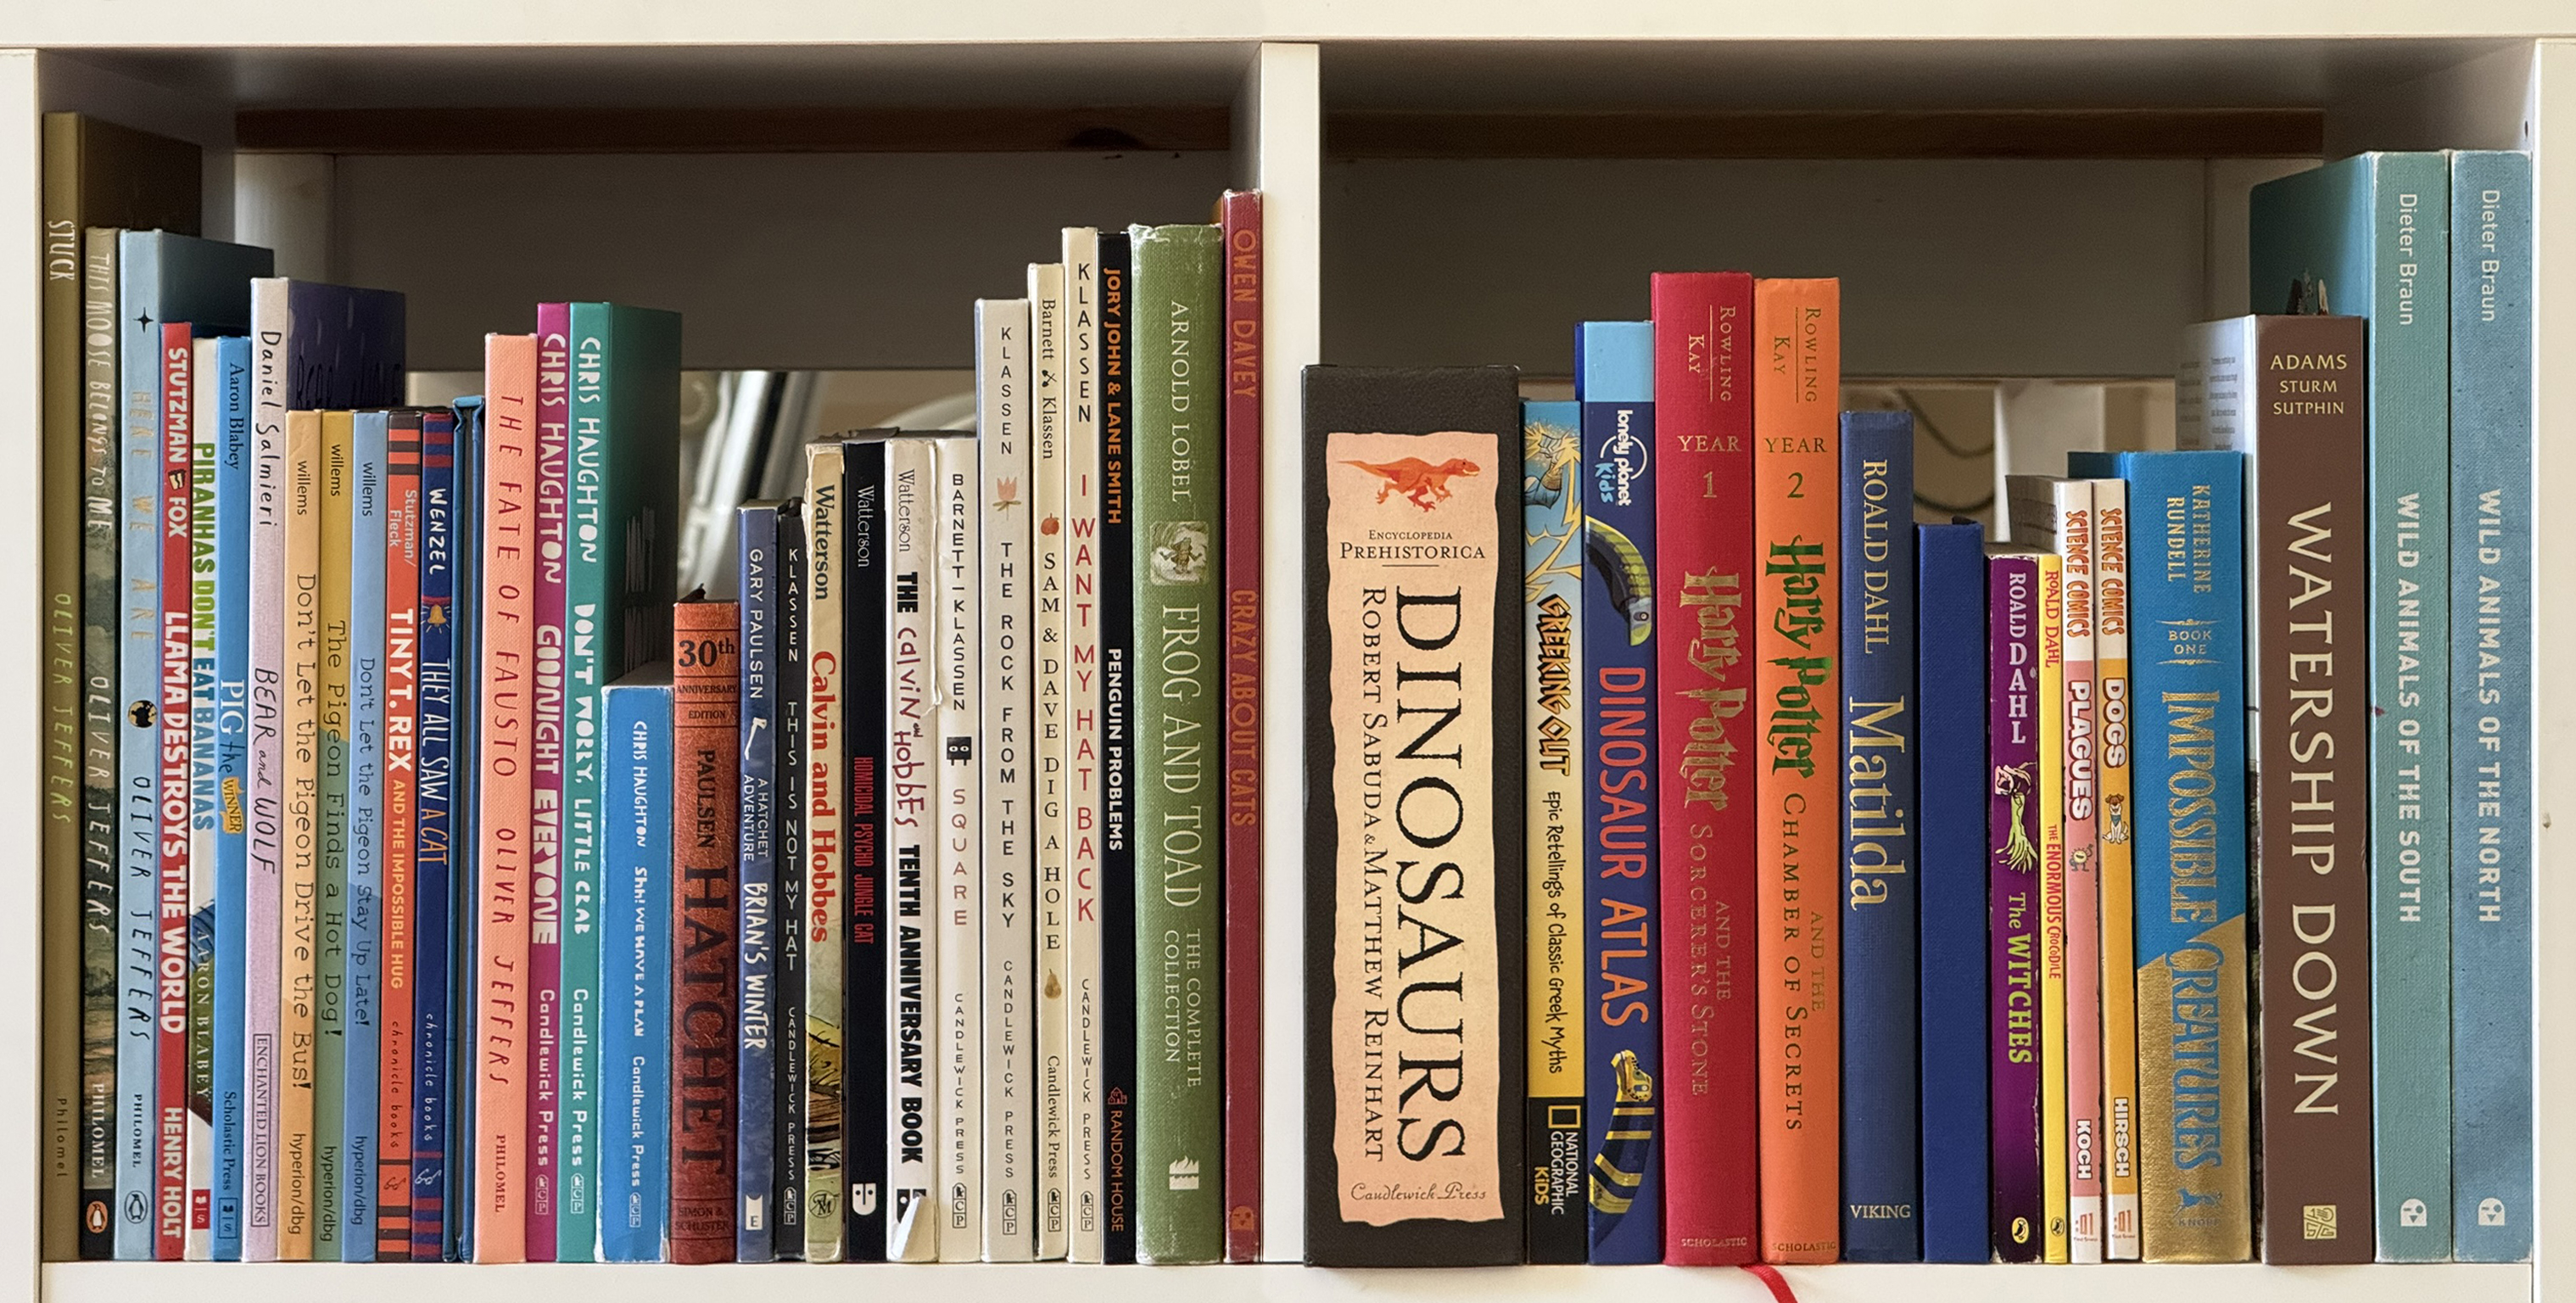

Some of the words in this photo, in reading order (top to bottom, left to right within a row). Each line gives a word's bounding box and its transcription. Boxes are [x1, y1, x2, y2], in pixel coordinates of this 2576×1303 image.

[48, 221, 75, 281] STUCK
[2400, 194, 2417, 256] Dieter
[2482, 190, 2499, 253] Dieter
[1107, 269, 1122, 318] JORY
[2400, 264, 2417, 326] Braun
[2482, 260, 2499, 322] Braun
[1042, 299, 1056, 360] Barnett
[1107, 322, 1122, 376] JOHN
[1171, 300, 1190, 412] ARNOLD
[2270, 353, 2348, 370] ADAMS
[228, 362, 244, 413] Aaron
[260, 331, 282, 408] Daniel
[541, 333, 565, 405] CHRIS
[1107, 382, 1122, 396] &
[2280, 382, 2338, 394] STURM
[225, 417, 245, 469] Blabey
[1042, 396, 1056, 459] Klassen
[1107, 402, 1122, 456] LANE
[1678, 435, 1743, 452] YEAR
[1764, 438, 1827, 453] YEAR
[2274, 403, 2344, 416] SUTPHIN
[257, 423, 279, 526] Salmieri
[330, 444, 344, 496] willems
[1107, 461, 1122, 524] SMITH
[1171, 423, 1191, 503] LOBEL
[1702, 473, 1717, 498] 1
[1787, 473, 1805, 498] 2
[192, 443, 215, 573] PIRANHAS
[388, 509, 402, 547] Fleck
[404, 489, 416, 567] Stutzman/
[428, 489, 448, 575] WENZEL
[539, 424, 564, 584] HAUGHTON
[857, 485, 874, 567] Watterson
[898, 468, 916, 552] Watterson
[1367, 529, 1454, 540] ENCYCLOPEDIA
[1863, 461, 1888, 562] ROALD
[2101, 508, 2125, 572] SCIENCE
[2167, 497, 2185, 582] RUNDELL
[2193, 485, 2211, 593] KATHERINE
[2478, 489, 2501, 564] WILD
[750, 549, 763, 601] GARY
[814, 484, 835, 600] Watterson
[1339, 542, 1485, 559] PREHISTORICA
[2065, 510, 2091, 573] SCIENCE
[192, 579, 215, 651] DON'T
[296, 573, 317, 651] Don't
[1679, 566, 1746, 681] Harry
[1765, 535, 1827, 651] Harry
[1864, 570, 1889, 654] DAHL
[2046, 570, 2060, 619] ROALD
[2065, 580, 2091, 638] COMICS
[2101, 579, 2126, 635] COMICS
[164, 612, 189, 704] LLAMA
[678, 640, 735, 667] 30th
[750, 610, 763, 698] PAULSEN
[1161, 603, 1200, 698] FROG
[1362, 586, 1388, 704] ROBERT
[2044, 627, 2060, 667] DAHL
[2478, 576, 2500, 705] ANIMALS
[192, 657, 215, 701] EAT
[296, 662, 316, 707] Let
[536, 624, 561, 774] GOODNIGHT
[812, 651, 835, 752] Calvin
[1108, 649, 1123, 742] PENGUIN
[2288, 501, 2333, 875] WATERSHIP
[296, 721, 313, 763] the
[633, 721, 647, 759] CHRIS
[1162, 713, 1201, 793] AND
[1676, 688, 1747, 812] Potter
[1766, 657, 1836, 780] Potter
[2069, 680, 2093, 821] PLAGUES
[2104, 677, 2128, 769] DOGS
[2479, 717, 2500, 751] OF
[162, 713, 187, 857] DESTROYS
[193, 707, 214, 830] BANANAS
[696, 750, 716, 848] PAULSEN
[812, 763, 835, 817] and
[854, 758, 873, 817] HOMICIDAL
[1109, 747, 1124, 851] PROBLEMS
[1363, 713, 1386, 828] SABUDA
[1545, 790, 1563, 821] Epic
[1600, 666, 1647, 879] DINOSAUR
[1847, 696, 1906, 911] Matilda
[2479, 763, 2500, 817] THE
[289, 777, 314, 868] Pigeon
[633, 767, 647, 847] HAUGHTON
[1364, 834, 1376, 843] &
[2161, 691, 2220, 922] IMPOSSIBLE
[533, 789, 557, 944] EVERYONE
[854, 824, 873, 867] PSYCHO
[1164, 806, 1203, 908] TOAD
[1396, 585, 1465, 1162] DINOSAURS
[1543, 825, 1566, 898] Retellings
[1782, 793, 1804, 940] CHAMBER
[2478, 828, 2500, 922] NORTH
[161, 866, 186, 919] THE
[293, 882, 314, 962] Drive
[811, 829, 835, 942] Hobbes
[854, 875, 873, 916] JUNGLE
[1364, 847, 1389, 998] MATTHEW
[1548, 903, 1566, 918] of
[1689, 824, 1713, 996] SORCERER'S
[2008, 892, 2027, 929] The
[746, 883, 770, 965] BRIAN'S
[854, 924, 874, 944] CAT
[1187, 929, 1200, 972] THE
[1548, 924, 1567, 973] Classic
[161, 927, 186, 1034] WORLD
[293, 974, 312, 1018] the
[1165, 930, 1180, 1063] COLLECTION
[1600, 898, 1649, 1026] ATLAS
[1784, 958, 1802, 993] OF
[2007, 933, 2032, 1064] WITCHES
[684, 865, 728, 1175] HATCHET
[746, 975, 769, 1049] WINTER
[1187, 977, 1202, 1087] COMPLETE
[1545, 978, 1567, 1021] Greek
[2293, 904, 2338, 1115] DOWN
[254, 1038, 269, 1130] ENCHANTED
[292, 1032, 312, 1090] Bus!
[422, 1013, 438, 1086] chronicle
[1364, 1009, 1389, 1162] REINHART
[1542, 1027, 1567, 1074] Myths
[1691, 1004, 1714, 1095] STONE
[1784, 1006, 1808, 1130] SECRETS
[2166, 942, 2224, 1170] CREATURES
[92, 1083, 106, 1178] PHILOMEL
[132, 1093, 143, 1168] PHILOMEL
[222, 1091, 237, 1154] Scholastic
[423, 1098, 438, 1141] books
[631, 1056, 644, 1138] Candlewick
[1047, 1056, 1060, 1140] Candlewick
[57, 1099, 68, 1177] Philomel
[162, 1106, 182, 1179] HENRY
[254, 1134, 269, 1168] LION
[495, 1134, 506, 1212] PHILOMEL
[631, 1144, 643, 1186] Press
[1047, 1145, 1060, 1177] Press
[1111, 1110, 1122, 1177] RANDOM
[1551, 1131, 1564, 1216] GEOGRAPHIC
[1566, 1132, 1579, 1198] NATIONAL
[2076, 1118, 2093, 1181] KOCH
[2113, 1096, 2131, 1177] HIRSCH
[162, 1185, 182, 1238] HOLT
[223, 1160, 237, 1190] Press
[253, 1173, 269, 1223] BOOKS
[288, 1133, 305, 1235] hyperion/dbg
[1112, 1182, 1124, 1231] HOUSE
[1851, 1205, 1911, 1219] VIKING
